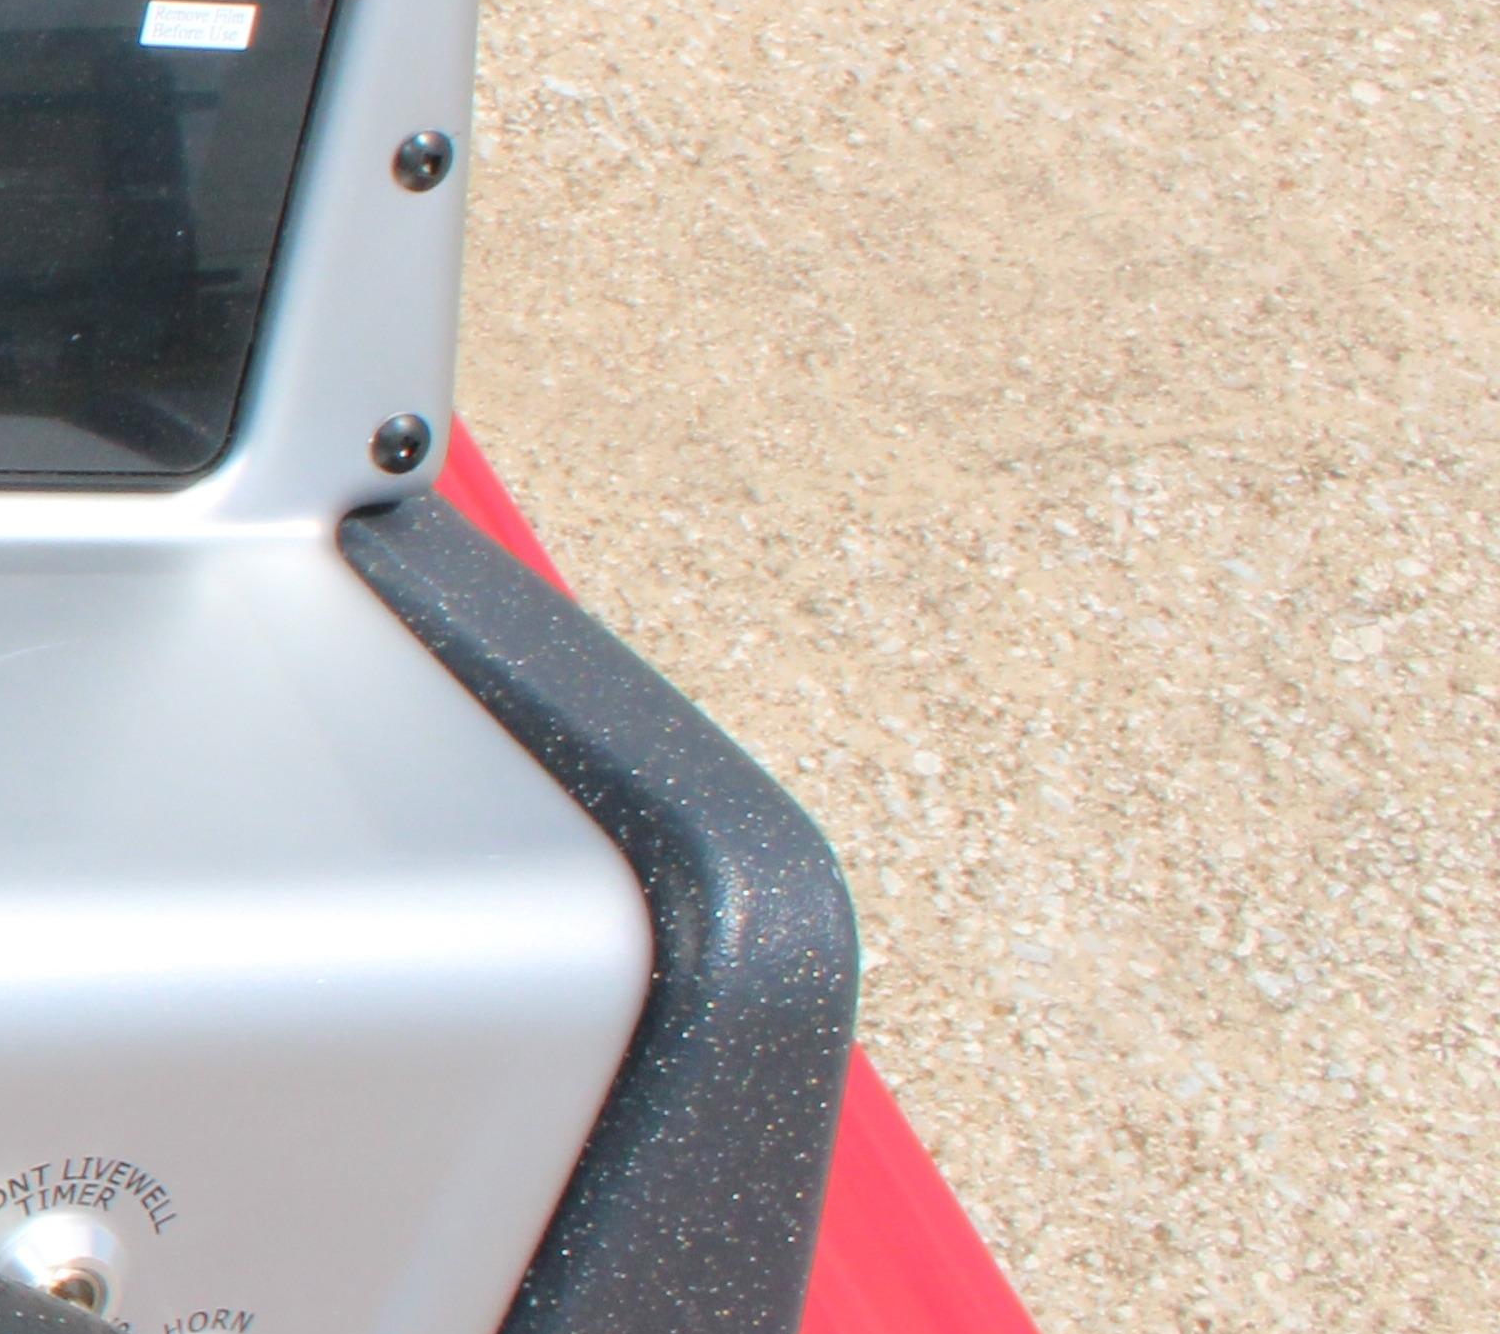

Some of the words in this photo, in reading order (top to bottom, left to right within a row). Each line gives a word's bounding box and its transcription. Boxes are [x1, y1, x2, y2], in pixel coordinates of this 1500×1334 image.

[154, 5, 210, 24] Remove
[213, 7, 246, 25] Film
[151, 22, 205, 41] Before
[209, 25, 240, 42] Use
[14, 1183, 116, 1216] TIMER
[61, 1156, 178, 1236] LIVEWELL
